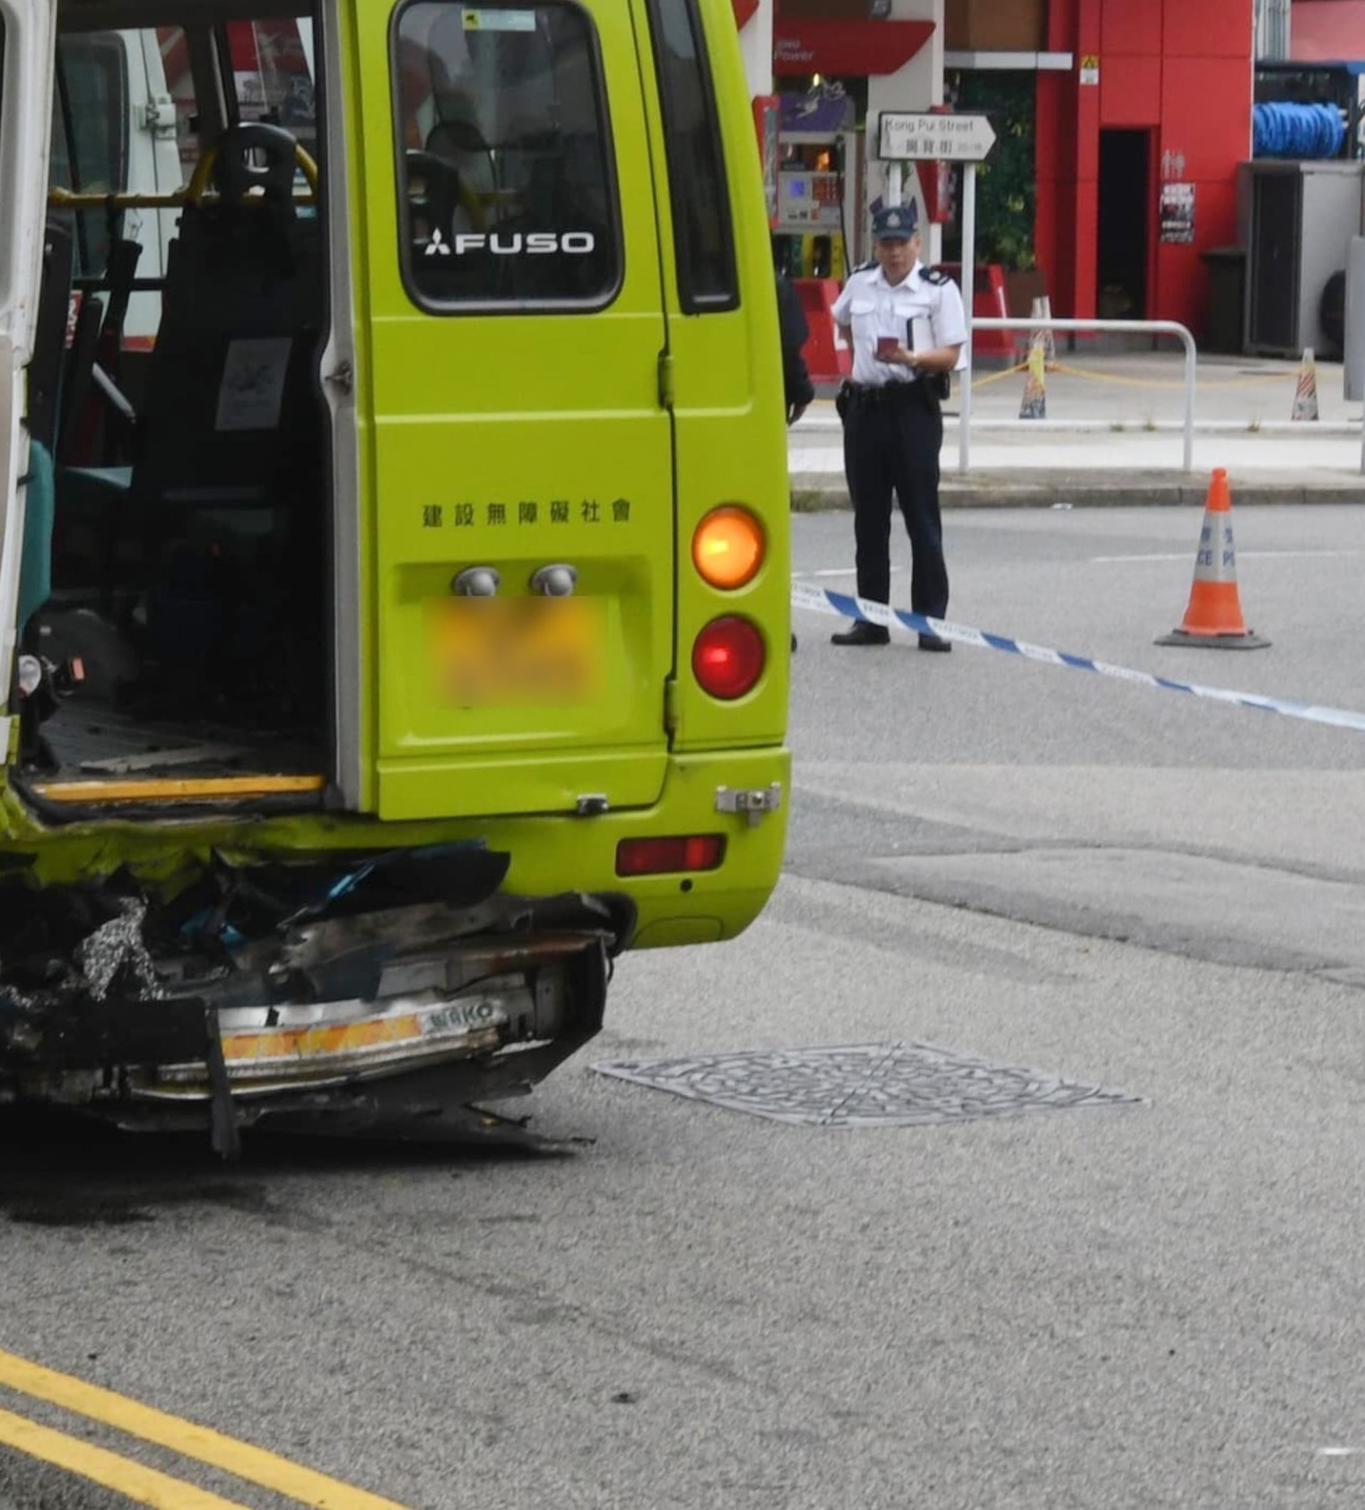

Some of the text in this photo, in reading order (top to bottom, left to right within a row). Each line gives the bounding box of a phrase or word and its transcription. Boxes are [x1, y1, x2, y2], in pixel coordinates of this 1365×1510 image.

[884, 119, 915, 133] Kong
[938, 119, 974, 131] Street
[455, 231, 595, 255] FUSO
[422, 497, 631, 528] 建設無障礙社會
